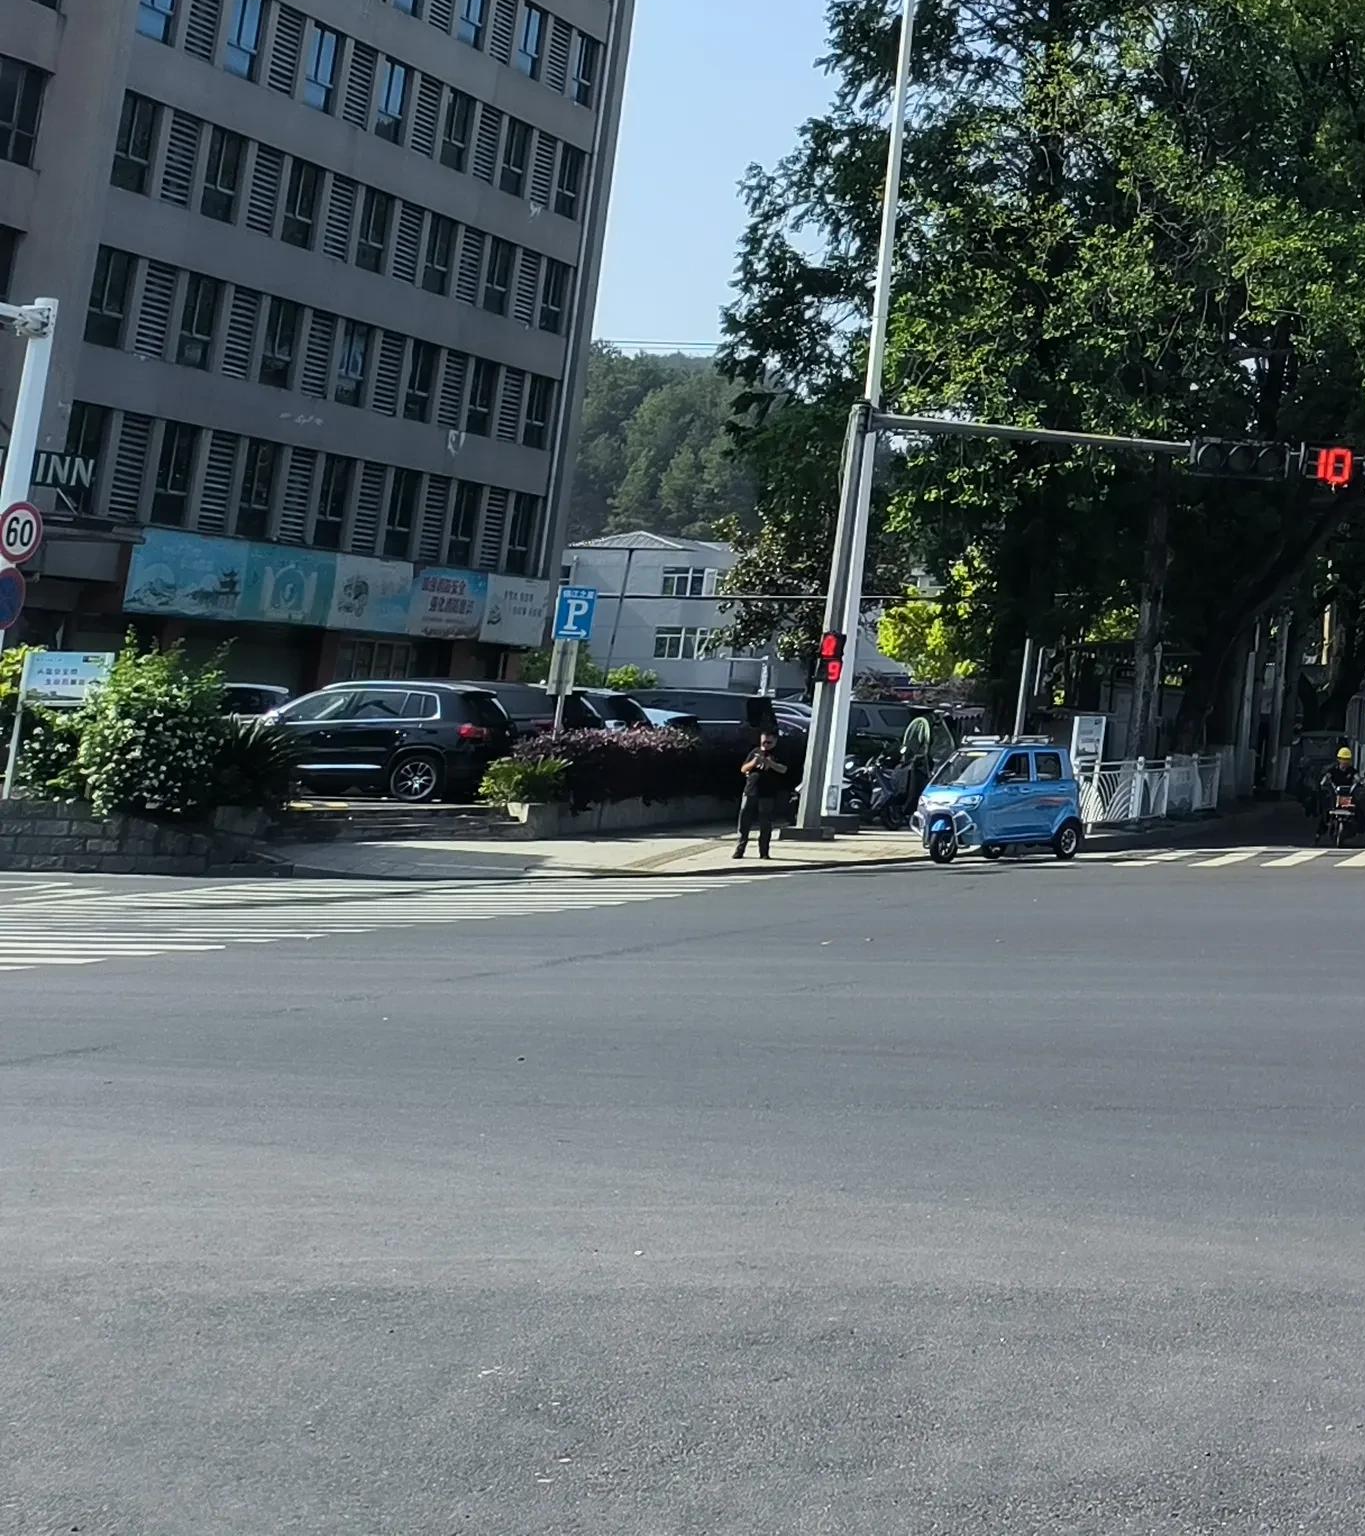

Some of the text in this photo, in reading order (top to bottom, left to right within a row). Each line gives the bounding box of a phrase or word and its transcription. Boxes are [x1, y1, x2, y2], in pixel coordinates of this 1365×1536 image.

[35, 453, 95, 488] INN
[1317, 448, 1351, 482] 10
[6, 516, 34, 547] 60
[563, 599, 589, 630] P
